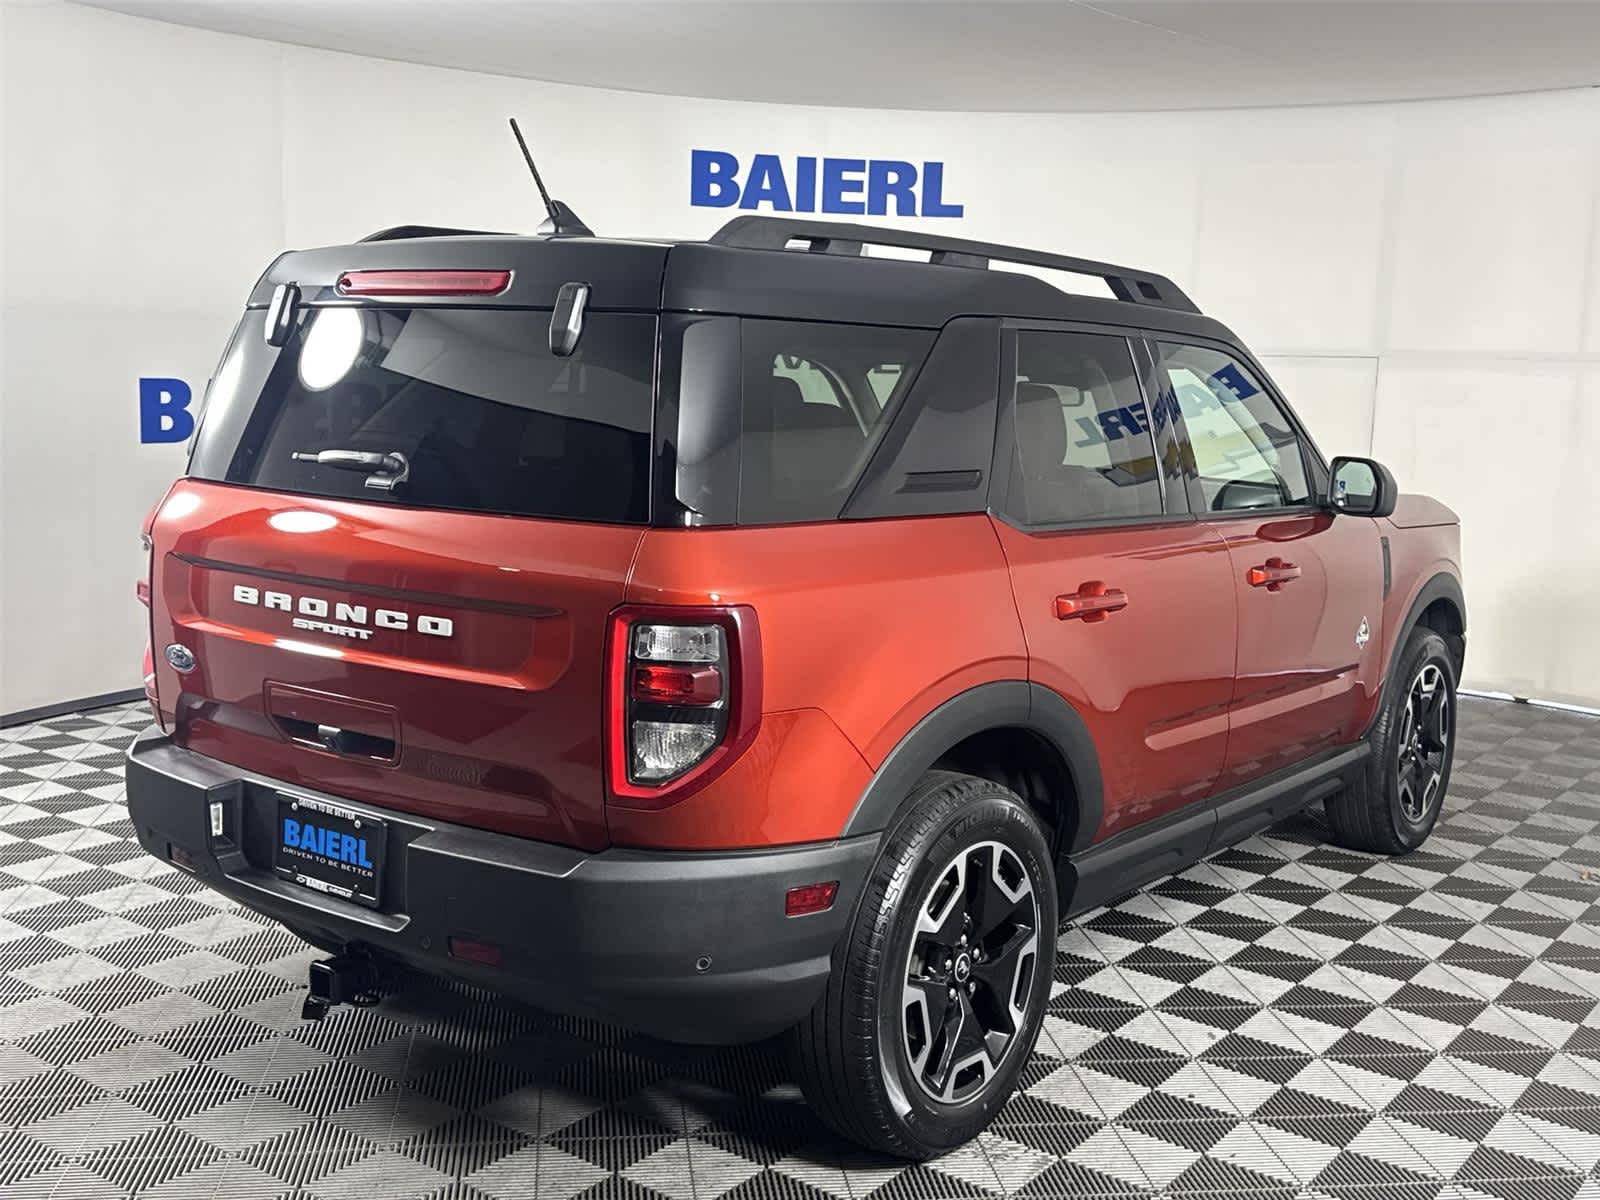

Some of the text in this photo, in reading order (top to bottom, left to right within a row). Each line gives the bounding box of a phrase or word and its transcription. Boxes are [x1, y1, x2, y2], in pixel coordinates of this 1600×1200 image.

[690, 149, 964, 218] BAIERL
[139, 377, 195, 444] B
[233, 585, 453, 637] BRONCO
[292, 618, 374, 640] SPORT
[282, 847, 373, 878] DRIVEN TO BE BETTER
[284, 818, 373, 869] BAIERL
